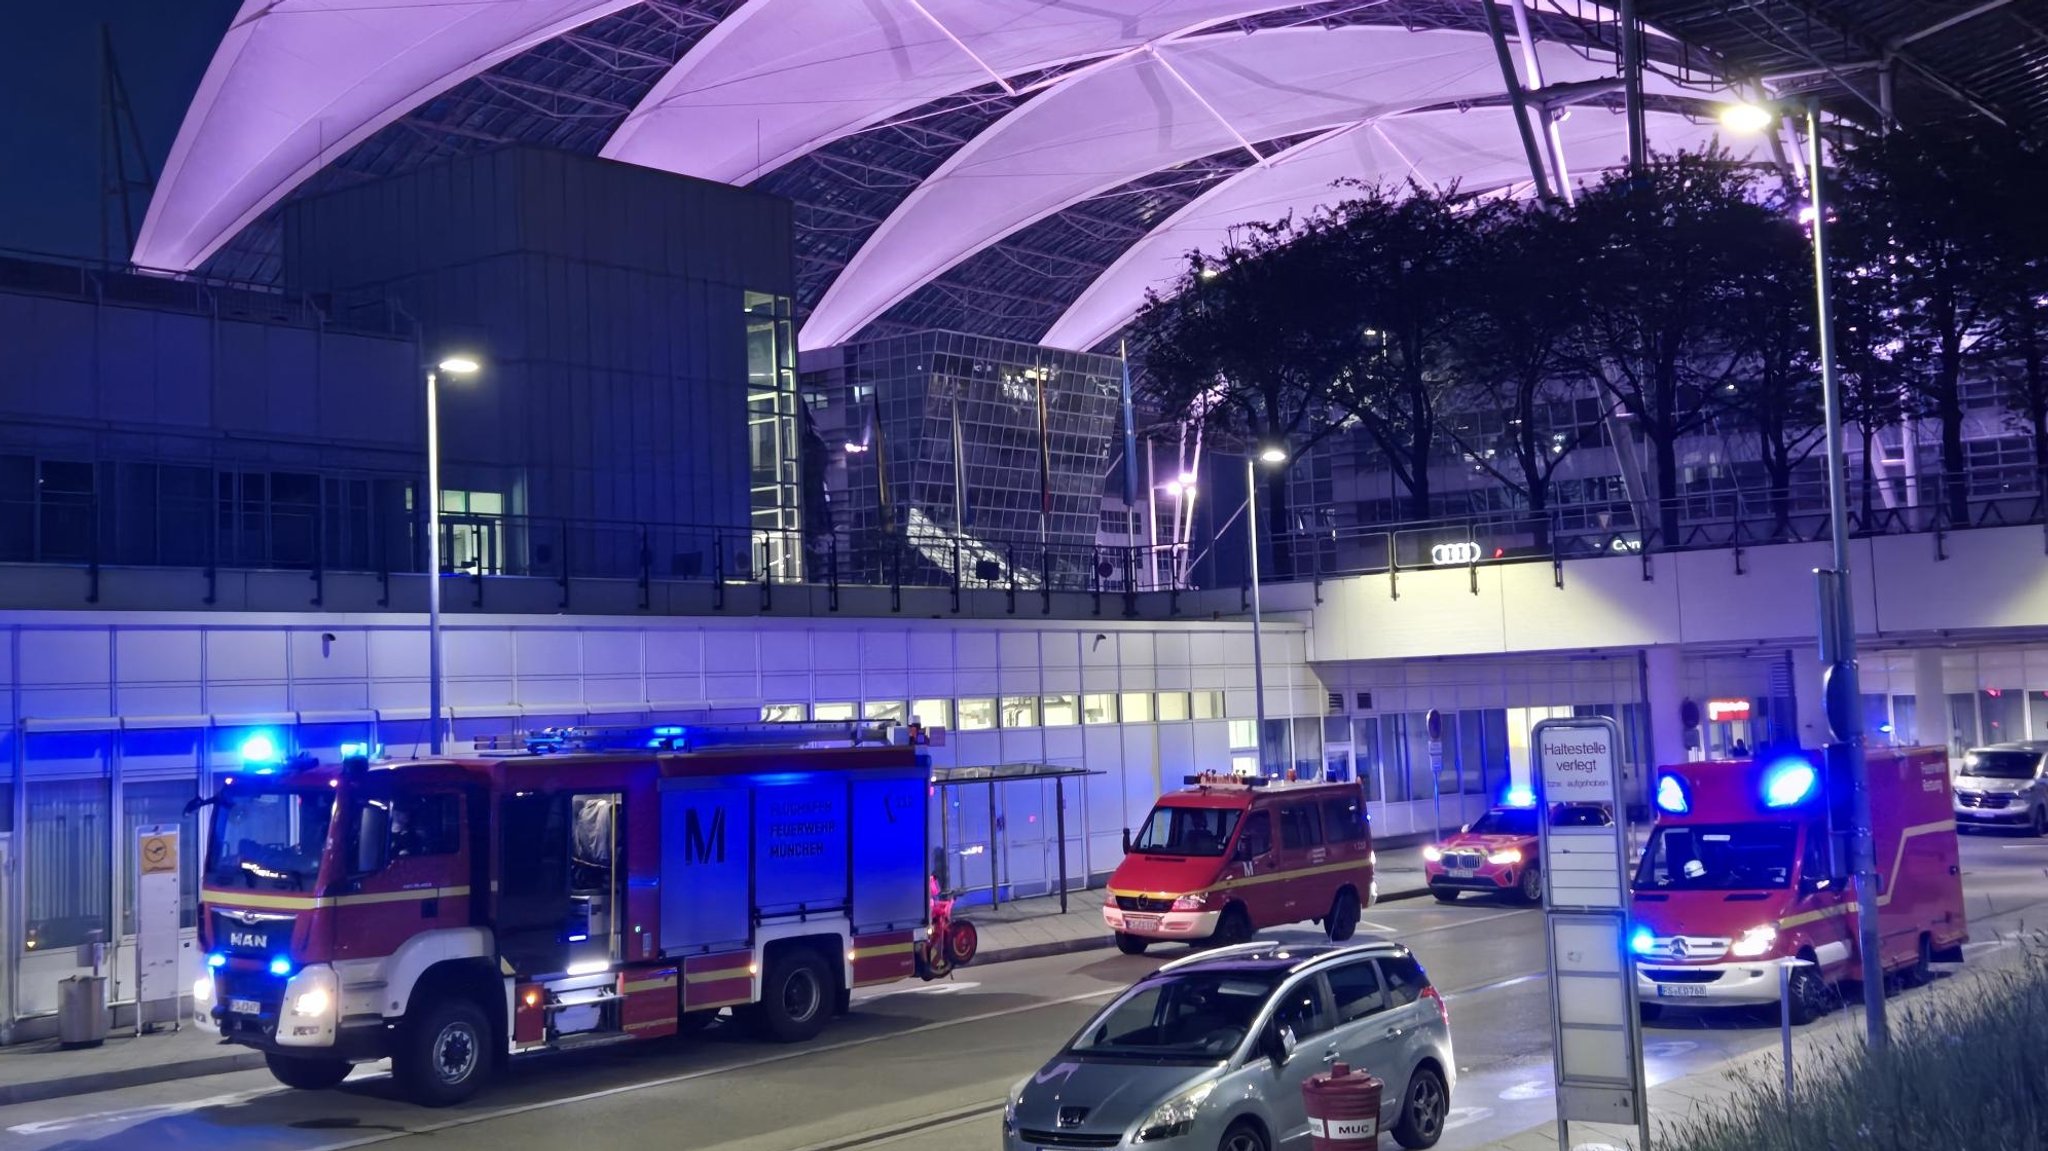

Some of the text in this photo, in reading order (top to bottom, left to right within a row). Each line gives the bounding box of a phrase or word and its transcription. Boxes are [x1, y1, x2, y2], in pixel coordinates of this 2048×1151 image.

[1544, 742, 1606, 755] Haltestelle
[1556, 759, 1597, 773] verlegt
[685, 806, 725, 865] M
[770, 820, 835, 838] FEUERWEHR
[230, 932, 267, 948] MAN
[1338, 1125, 1369, 1134] MUC
